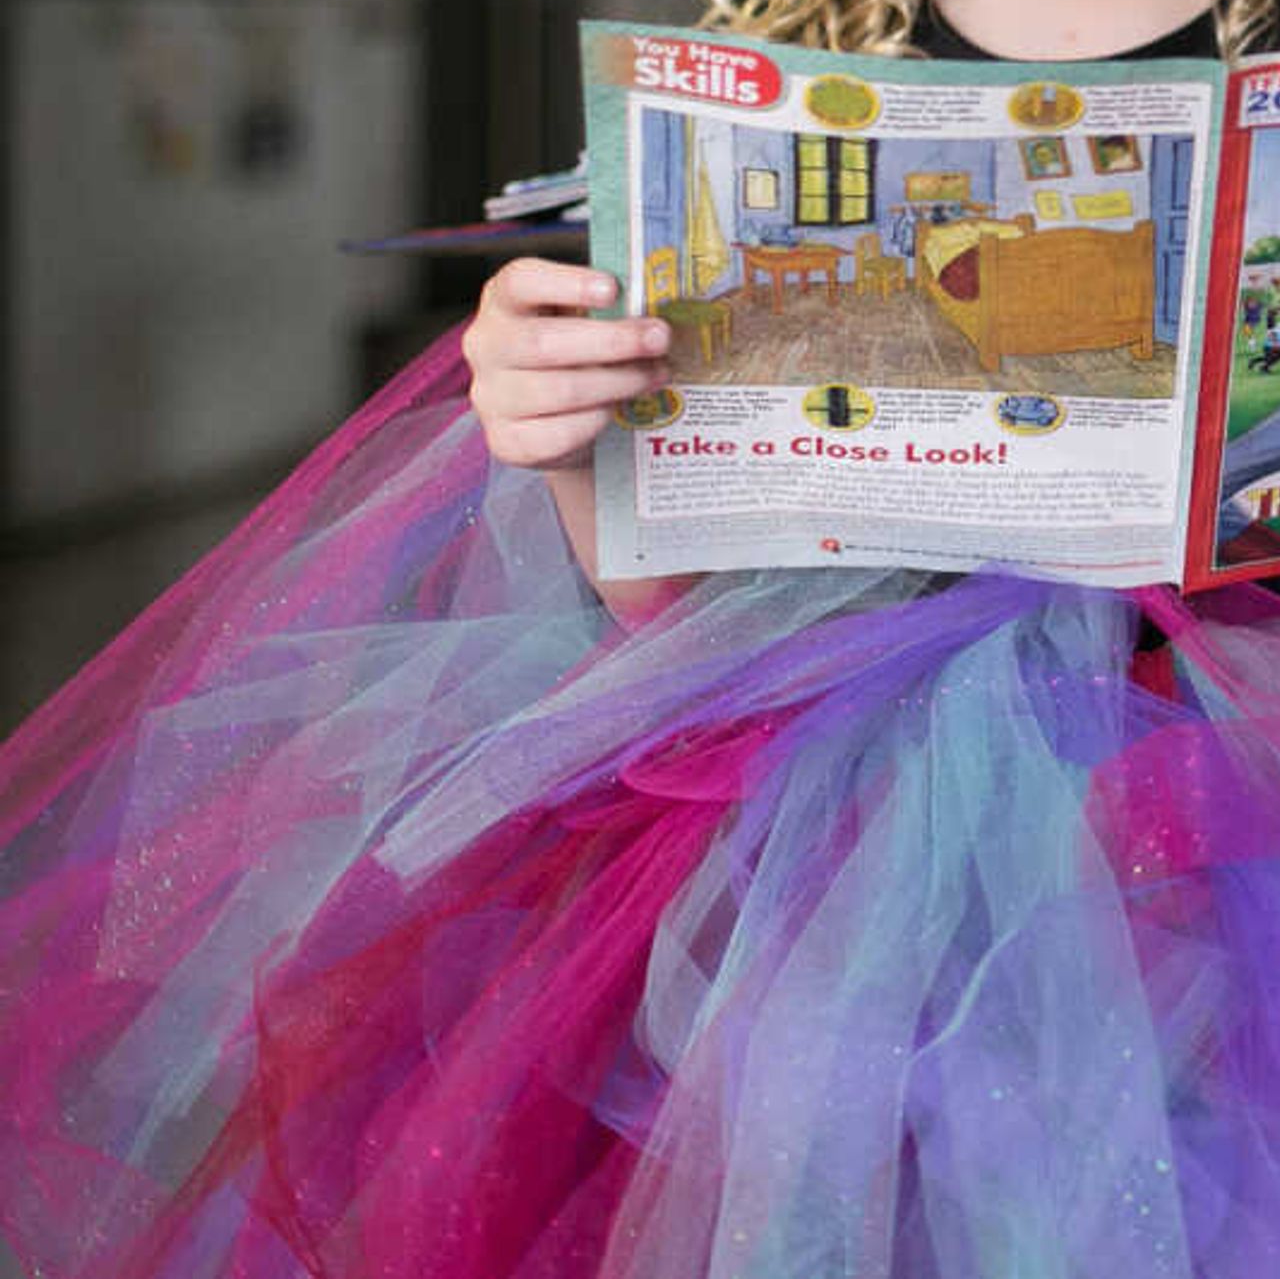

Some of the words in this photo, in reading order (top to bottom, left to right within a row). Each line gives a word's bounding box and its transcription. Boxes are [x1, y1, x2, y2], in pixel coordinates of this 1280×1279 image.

[633, 37, 680, 56] You
[689, 43, 758, 69] Have
[634, 56, 760, 104] Skills
[648, 435, 738, 456] Take
[752, 439, 776, 456] a
[790, 436, 891, 461] Close
[905, 442, 1008, 465] Look!
